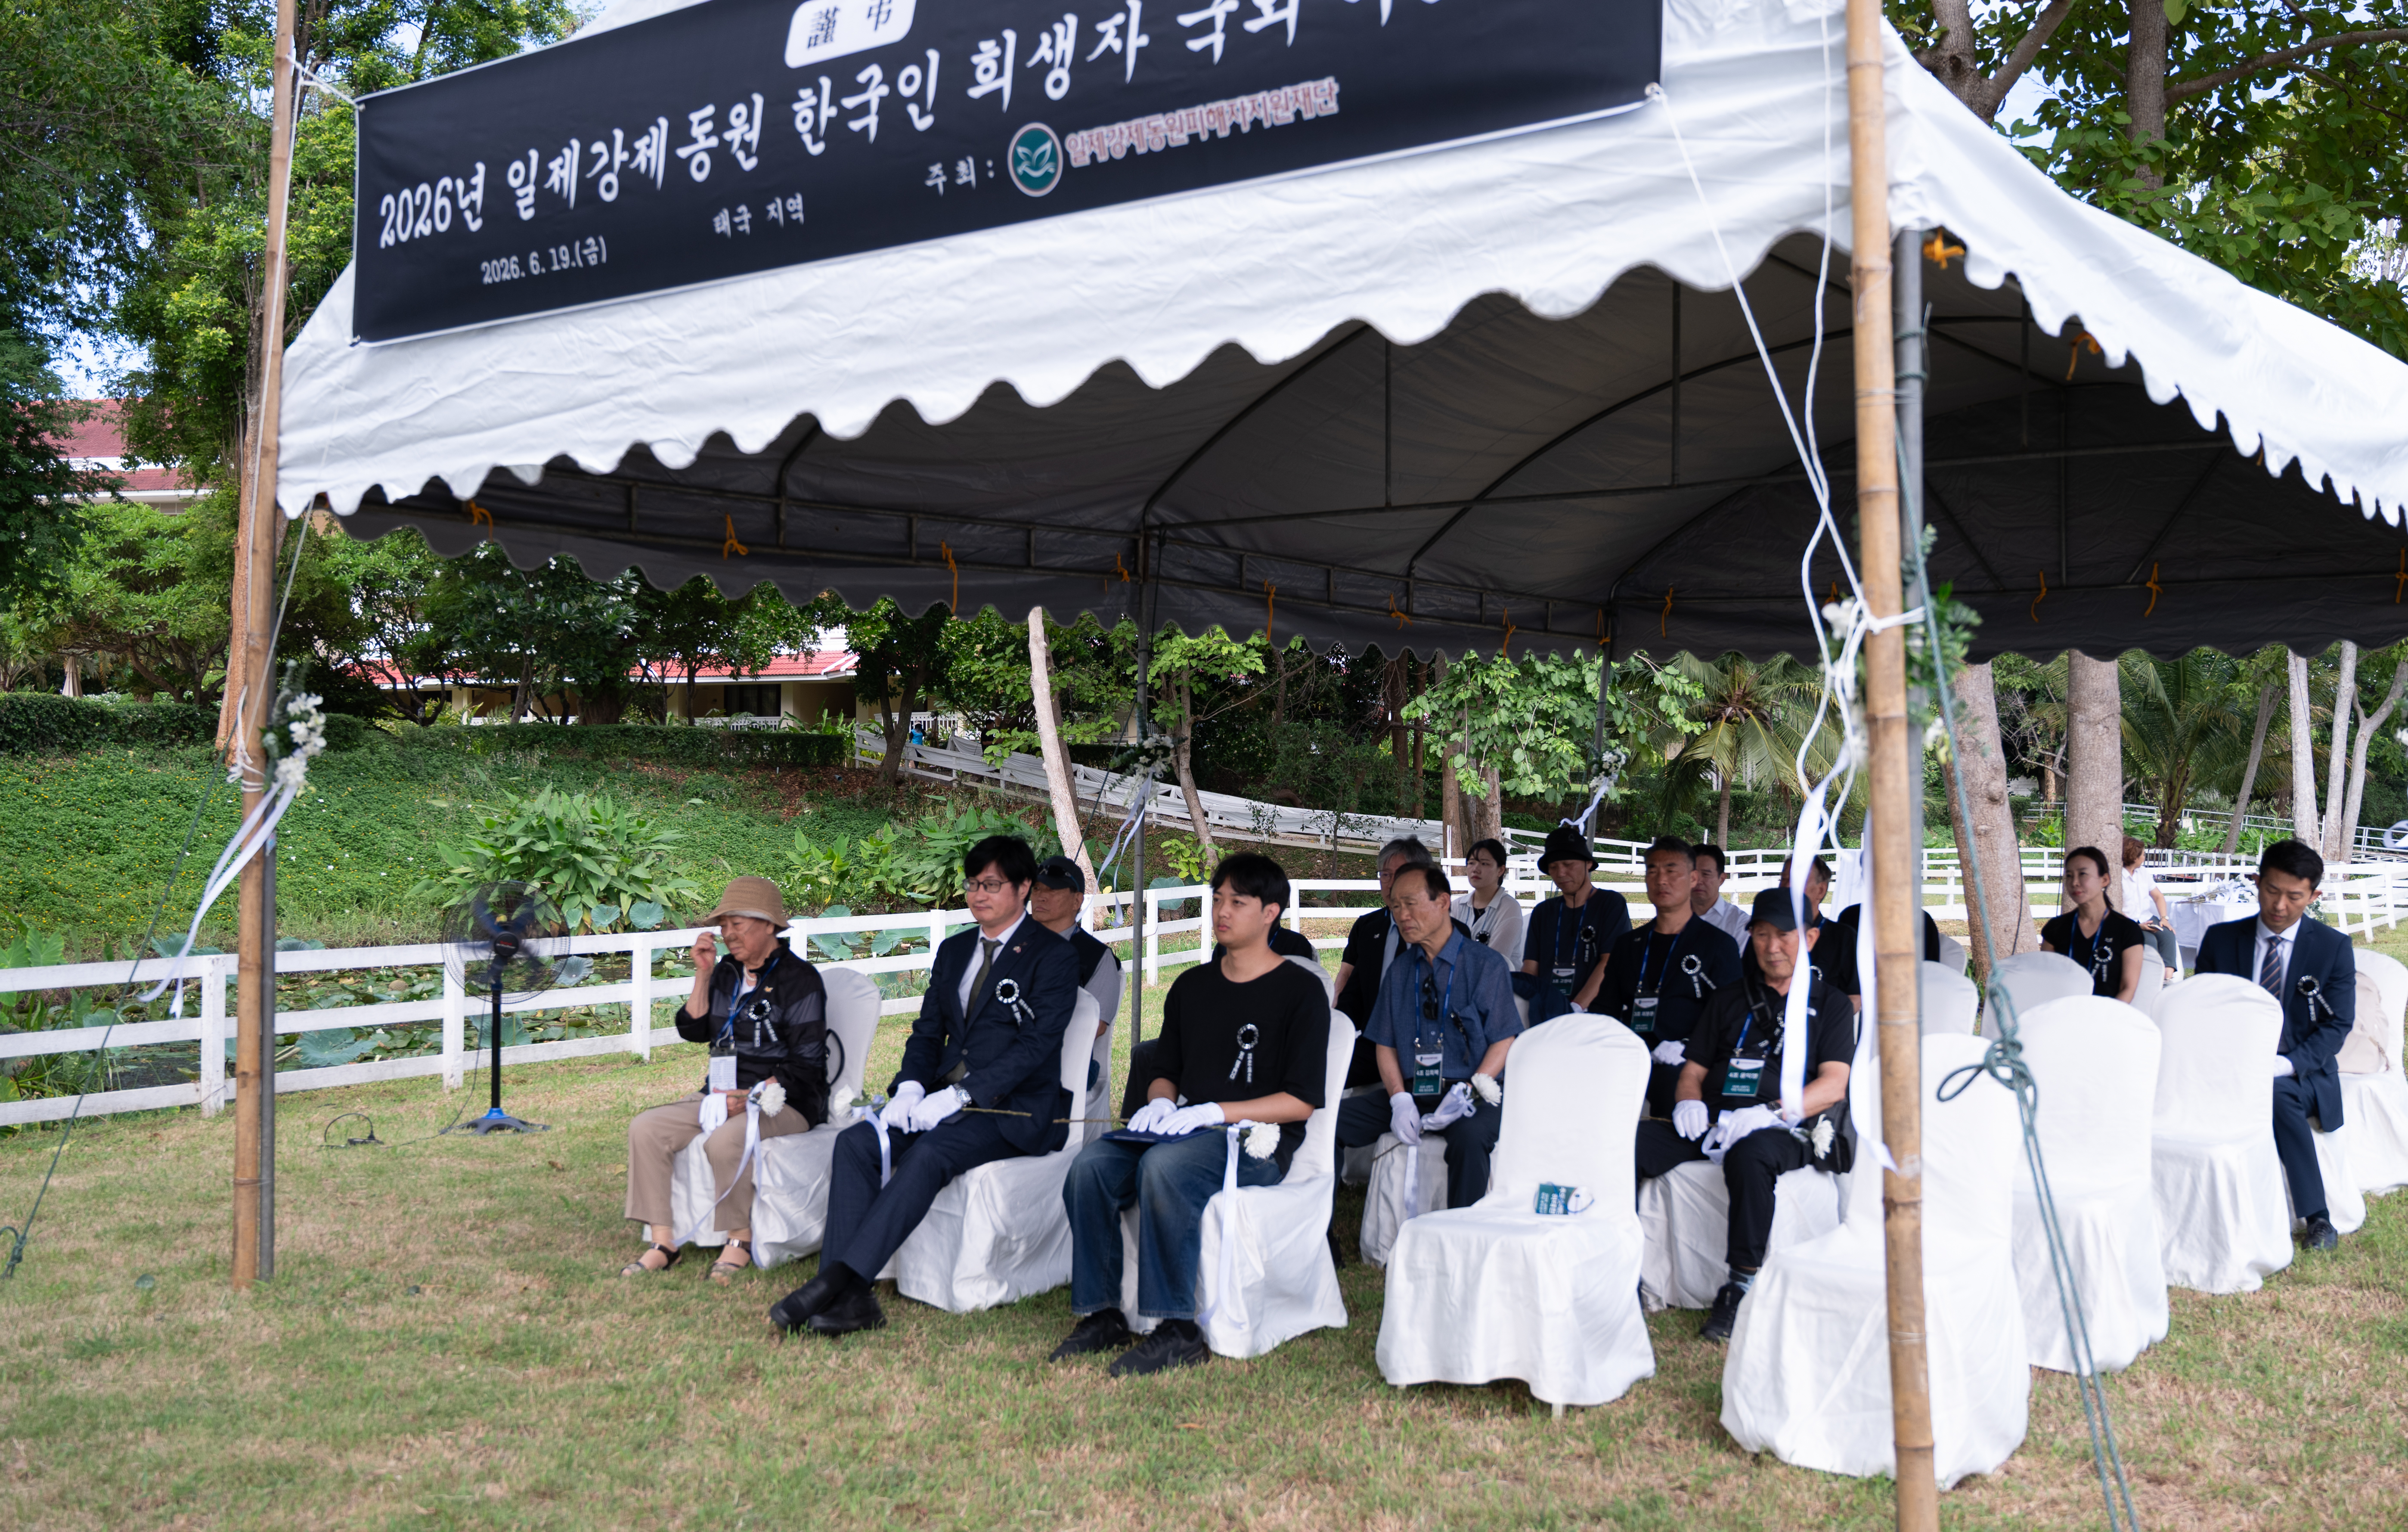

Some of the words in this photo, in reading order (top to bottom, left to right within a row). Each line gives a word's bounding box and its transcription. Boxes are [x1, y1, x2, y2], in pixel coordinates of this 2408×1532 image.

[380, 161, 486, 249] 2026년
[506, 93, 764, 221] 일제강제동원
[791, 49, 940, 156] 한국인
[967, 0, 1150, 113] 희생자
[1064, 76, 1340, 168] 일제강제동원피해자지원재단
[713, 207, 753, 239] 태국
[765, 192, 804, 229] 지역
[480, 255, 526, 285] 2026.
[529, 251, 546, 275] 6.
[548, 234, 607, 271] 19.(금)
